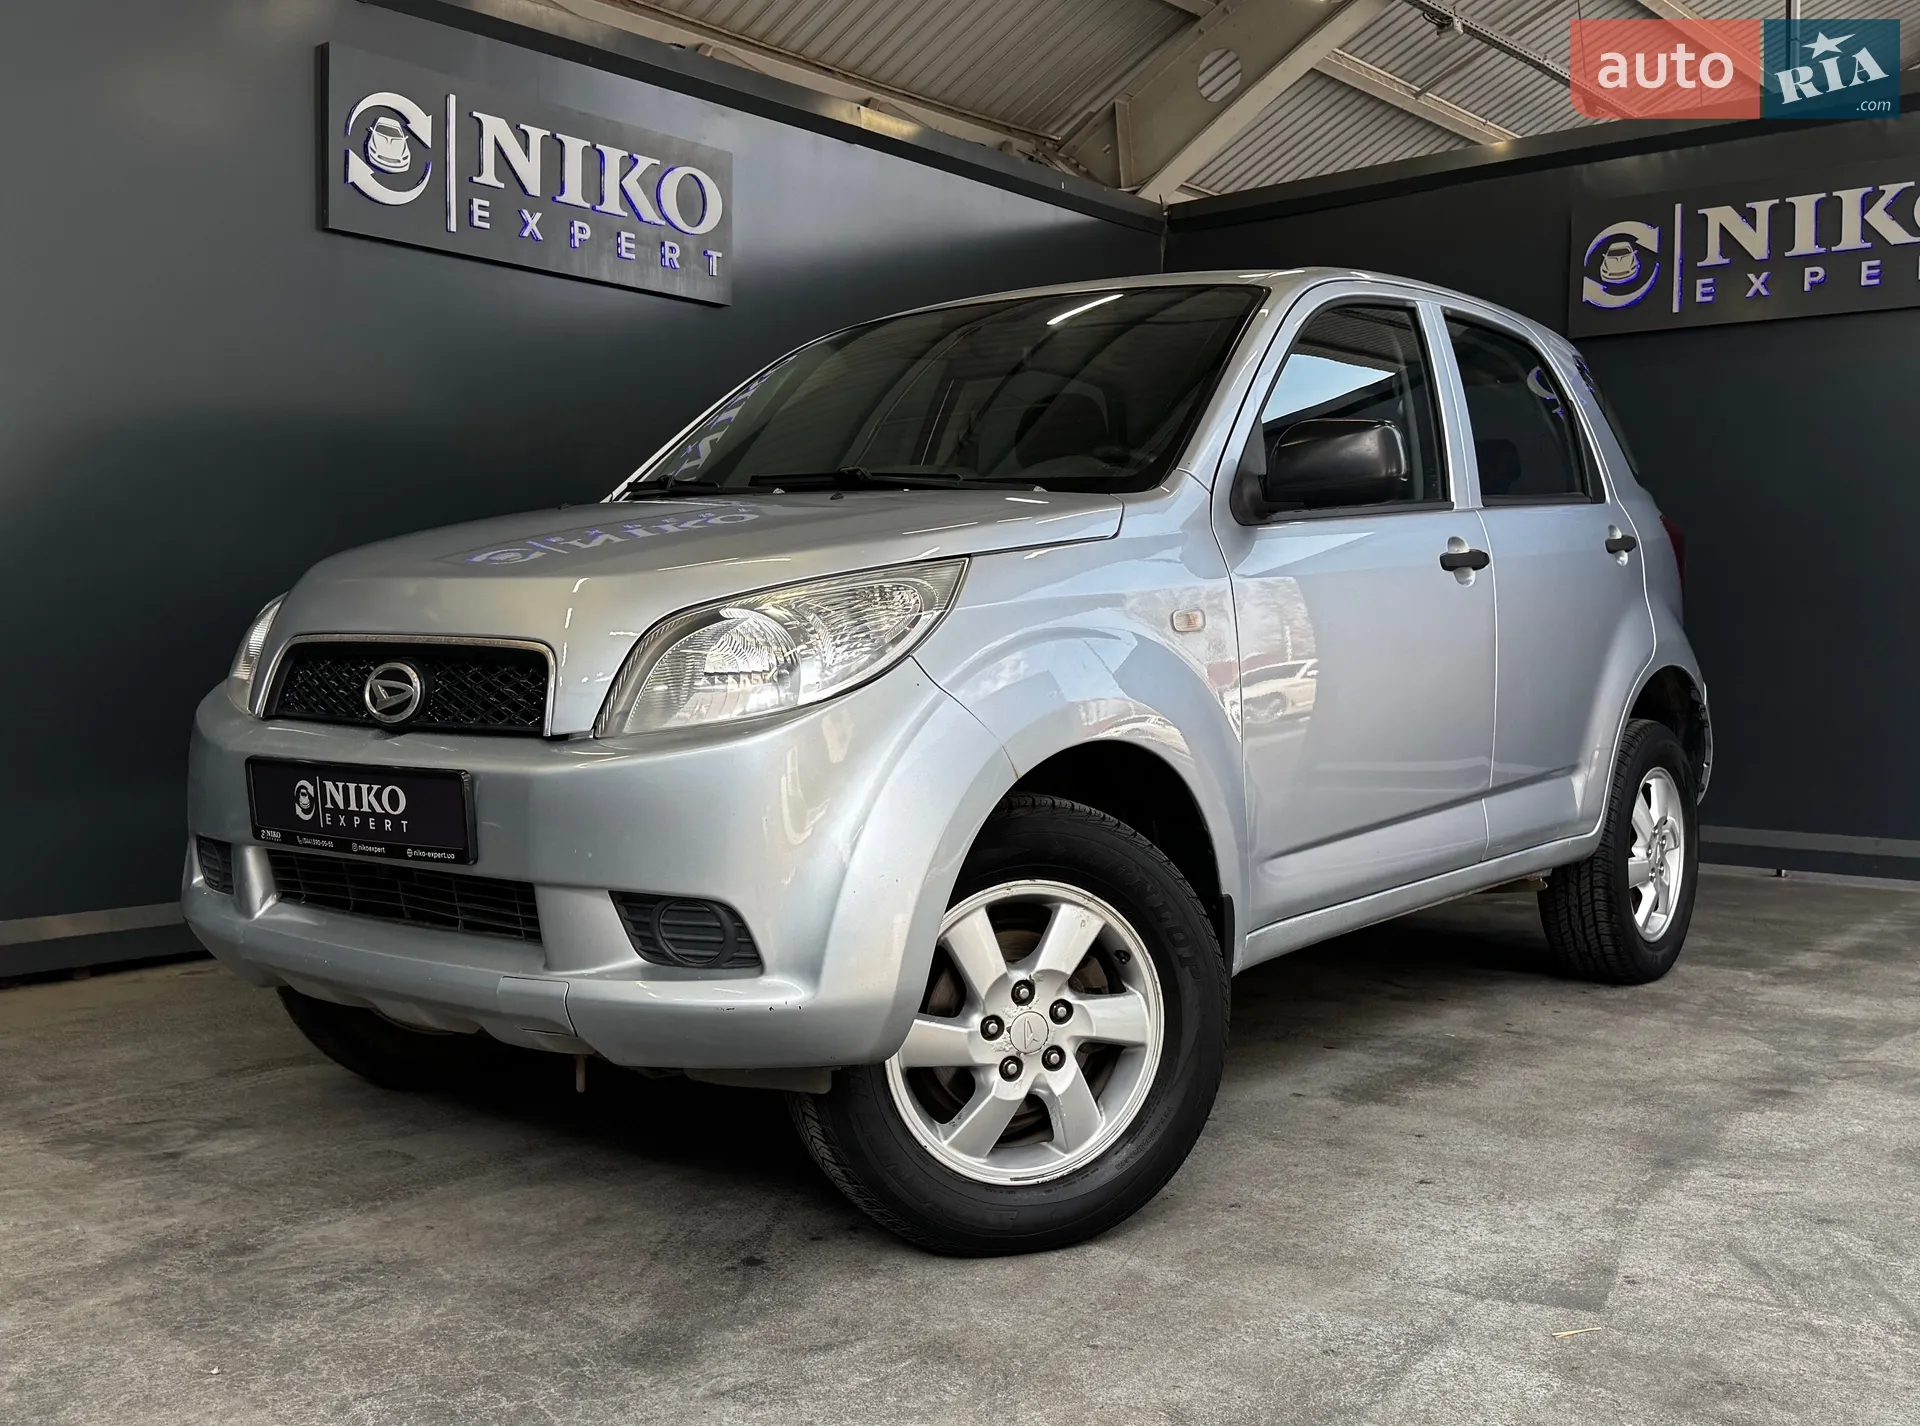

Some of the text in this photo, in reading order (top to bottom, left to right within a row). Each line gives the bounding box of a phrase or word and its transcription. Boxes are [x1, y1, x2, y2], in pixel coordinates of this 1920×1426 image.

[469, 110, 723, 236] NIKO
[469, 197, 722, 277] EXPERT
[1697, 181, 1920, 267] NIK
[1696, 256, 1920, 303] EXPE
[322, 780, 407, 815] NIKO
[266, 829, 281, 839] NIKO
[325, 813, 408, 833] EXPERT
[413, 849, 455, 860] niko-expert.ua
